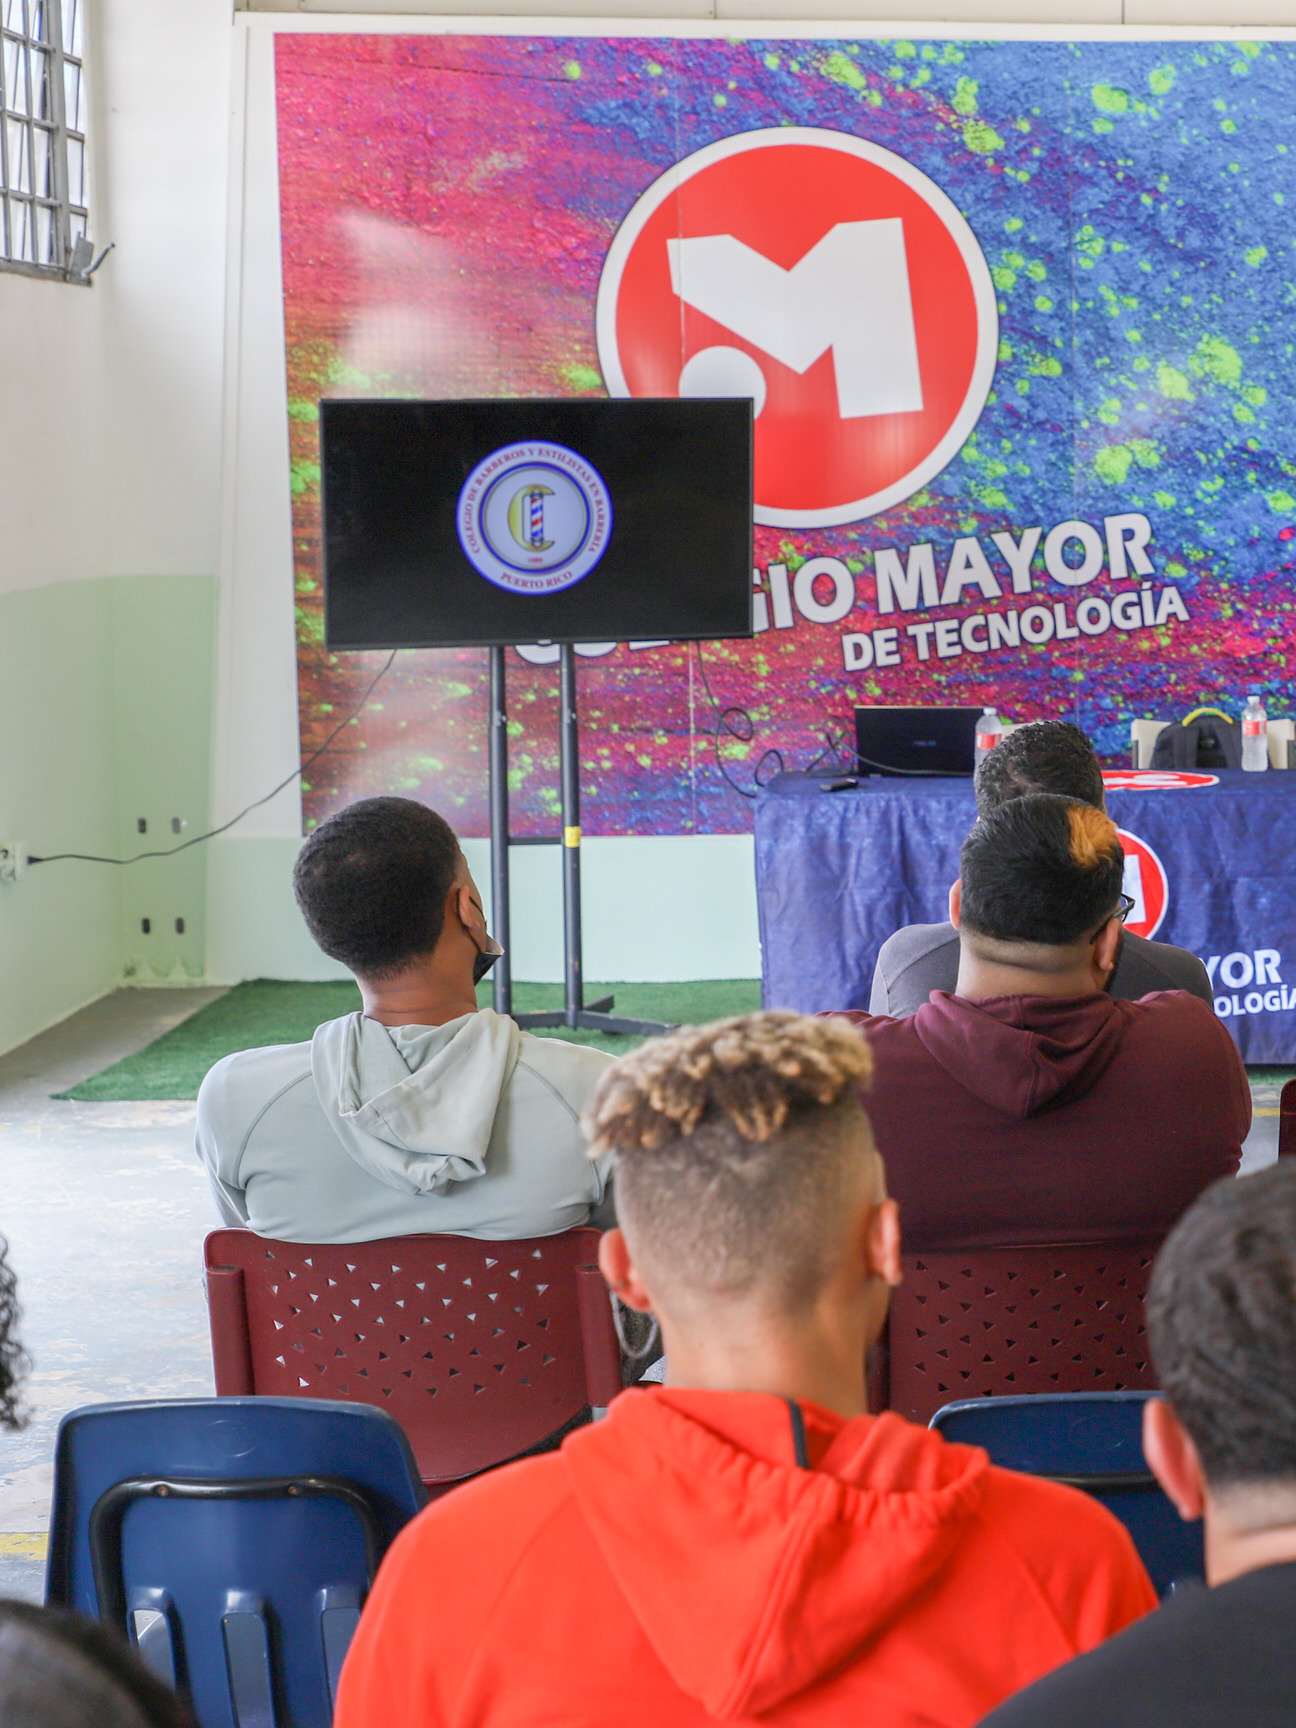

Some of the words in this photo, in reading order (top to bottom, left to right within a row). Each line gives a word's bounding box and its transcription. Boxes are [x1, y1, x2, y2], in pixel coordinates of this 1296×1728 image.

[474, 448, 526, 486] BARBEROS
[528, 447, 536, 457] Y
[538, 447, 593, 483] ESTILISTAS
[467, 486, 479, 501] DE
[588, 482, 601, 497] EN
[463, 503, 481, 554] COLEGIO
[501, 572, 544, 589] PUERTO
[545, 570, 573, 587] RICO
[875, 512, 1156, 615] MAYOR
[841, 632, 901, 672] DE
[907, 581, 1190, 661] TECNOLOGÍA
[1198, 948, 1282, 989] YOR
